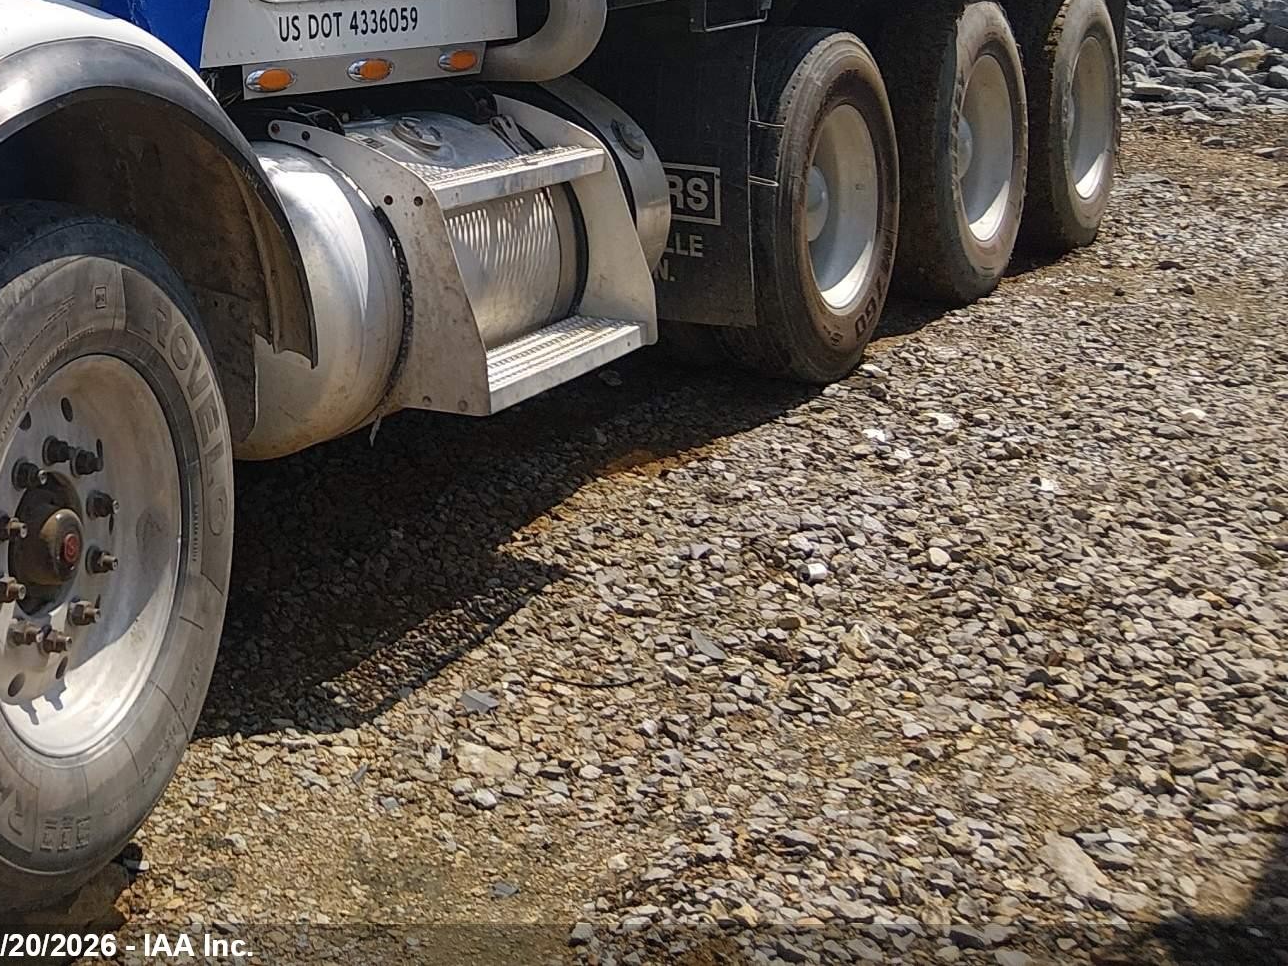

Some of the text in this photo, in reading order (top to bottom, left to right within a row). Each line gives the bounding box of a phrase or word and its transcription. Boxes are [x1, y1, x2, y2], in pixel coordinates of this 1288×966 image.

[278, 6, 419, 42] US DOT 4336059
[143, 302, 228, 536] ROVELO
